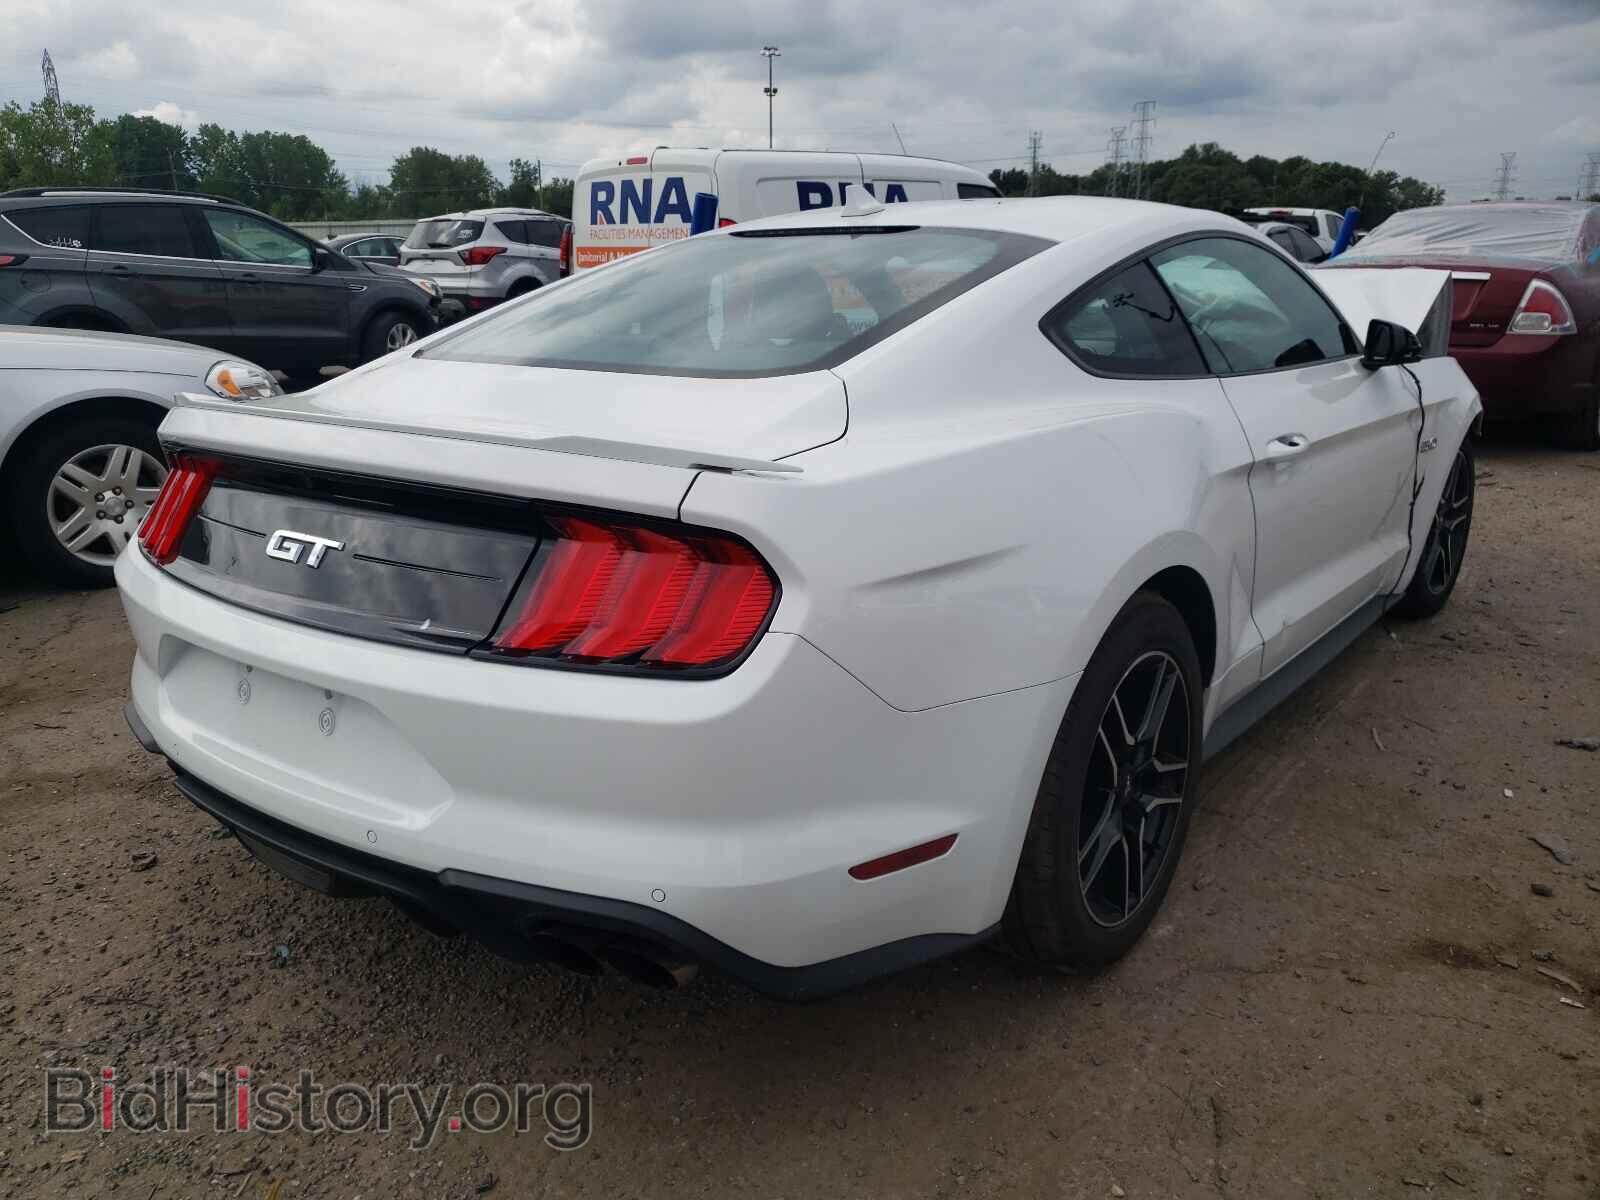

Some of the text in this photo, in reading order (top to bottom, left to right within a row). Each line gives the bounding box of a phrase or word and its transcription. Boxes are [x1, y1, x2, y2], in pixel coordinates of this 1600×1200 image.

[590, 177, 694, 225] RNA
[590, 227, 690, 240] FACILITIES MANAGEMEN
[266, 529, 346, 569] GT
